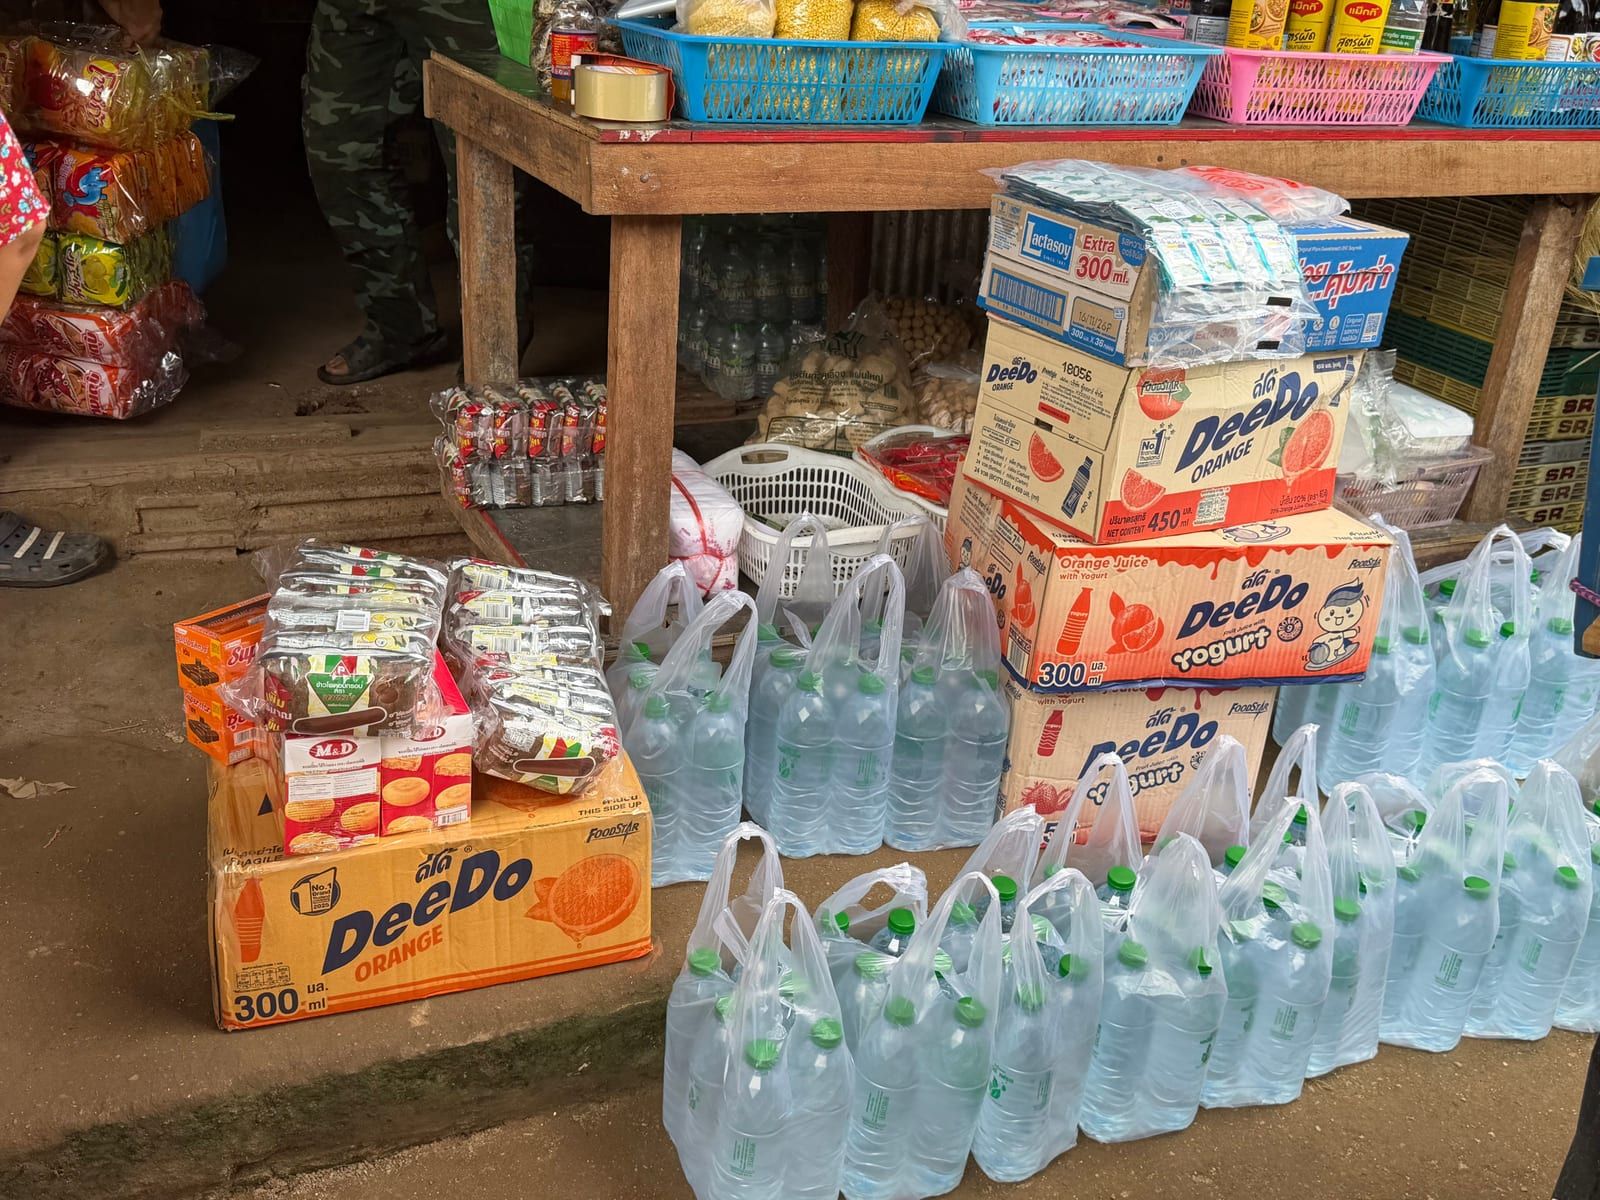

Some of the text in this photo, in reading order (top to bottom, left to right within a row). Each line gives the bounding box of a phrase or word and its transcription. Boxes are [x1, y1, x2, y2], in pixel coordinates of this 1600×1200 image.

[1023, 221, 1071, 260] Lactasoy
[1083, 235, 1115, 253] Extra
[1076, 255, 1129, 284] 300 ml.
[1071, 327, 1084, 339] 300
[986, 361, 1038, 384] DeeDo
[1062, 361, 1092, 382] 18056
[992, 383, 1014, 391] ORANGE
[1563, 399, 1593, 414] SR
[1175, 372, 1319, 473] DeeDo
[1558, 420, 1588, 433] SR
[1191, 438, 1254, 484] ORANGE
[1545, 467, 1575, 482] SR
[1540, 486, 1570, 502] SR
[1148, 510, 1181, 532] 450
[1533, 507, 1564, 522] SR
[1107, 525, 1145, 537] NET CONTENT
[1060, 557, 1149, 572] Orange Juice
[1080, 572, 1108, 581] Yogurt
[1241, 569, 1271, 590] ดีโด้
[1176, 574, 1309, 640] DeeDo
[227, 643, 257, 666] Sup
[1172, 626, 1271, 672] Yogurt
[338, 666, 345, 674] P
[1038, 663, 1086, 685] 300
[1088, 675, 1102, 684] ml
[1038, 697, 1085, 705] with Yogurt
[316, 742, 353, 758] M&D
[1078, 713, 1218, 780] DeeDo
[1087, 762, 1184, 806] Ygurt
[578, 808, 601, 816] THIS
[603, 804, 626, 812] SIDE
[415, 847, 457, 884] ดีโด้
[312, 883, 331, 891] No.1
[321, 850, 533, 976] DeeDo
[355, 924, 443, 982] ORANGE
[234, 983, 329, 1022] 300 มล.
[308, 999, 326, 1011] ml
